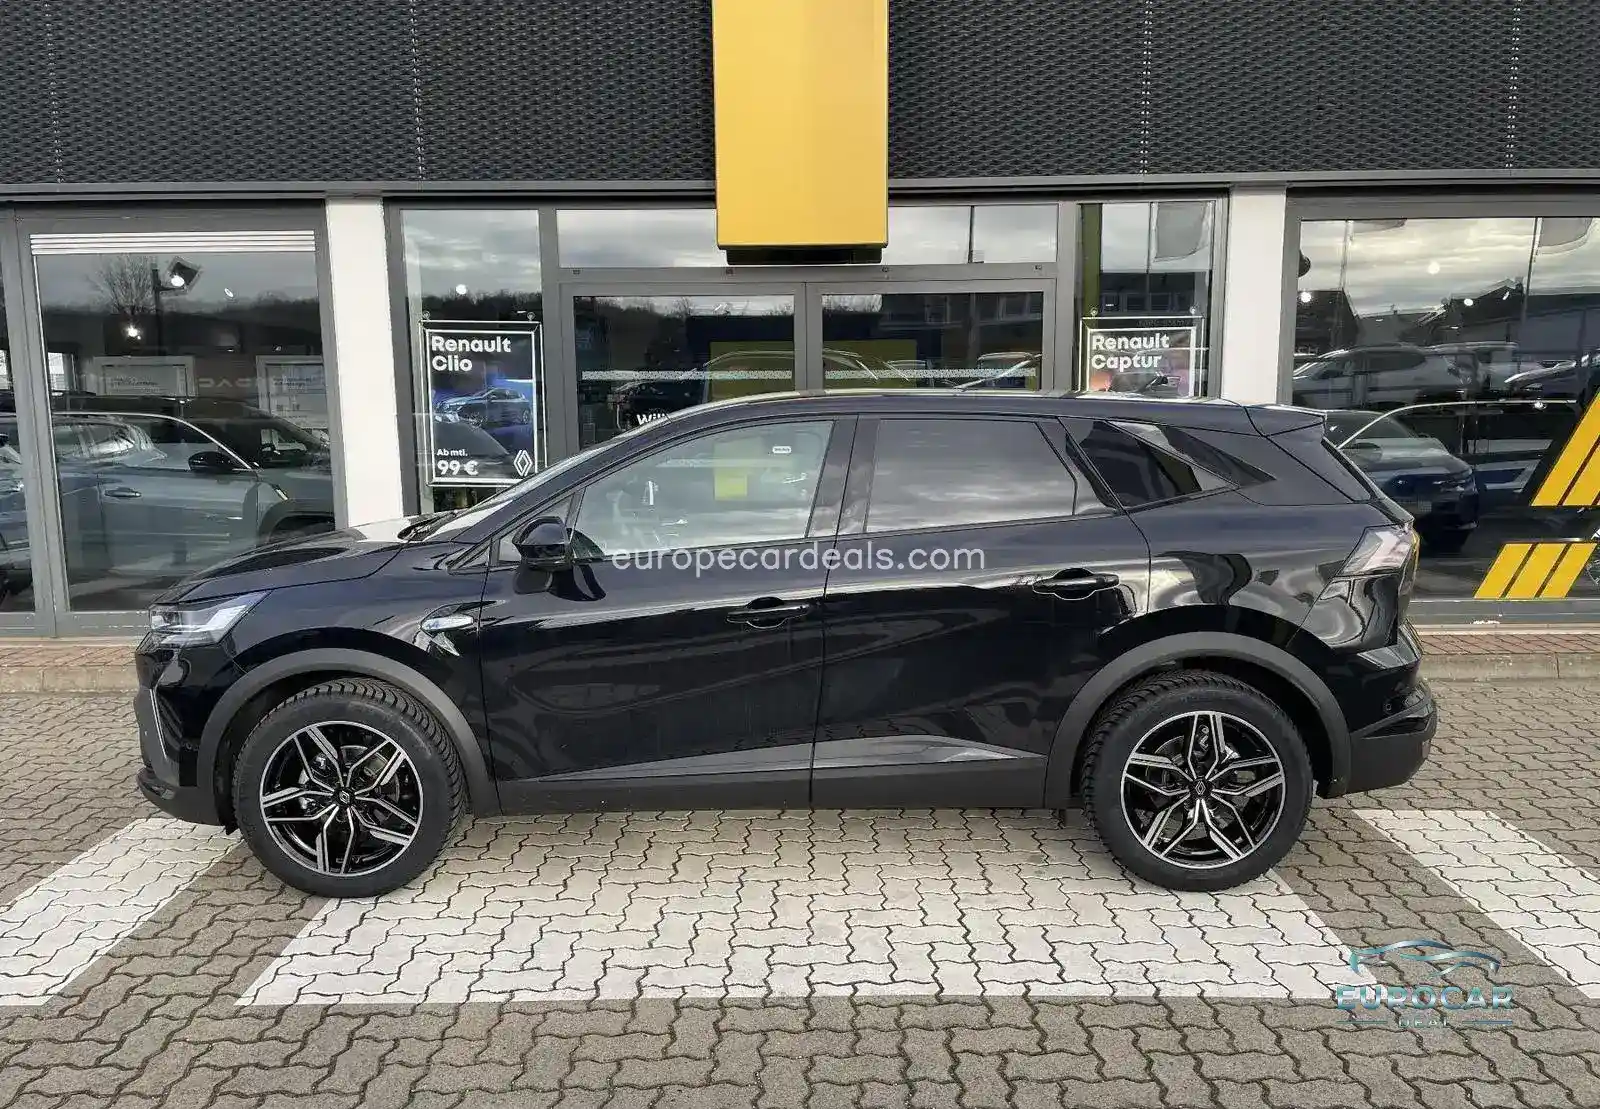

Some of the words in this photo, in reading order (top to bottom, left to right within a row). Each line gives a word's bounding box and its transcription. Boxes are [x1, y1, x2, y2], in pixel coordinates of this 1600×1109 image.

[431, 336, 511, 352] Renault
[1092, 333, 1169, 350] Renault
[431, 355, 472, 371] Clio
[1091, 353, 1162, 372] Captur
[437, 460, 460, 475] 99
[464, 460, 479, 475] €
